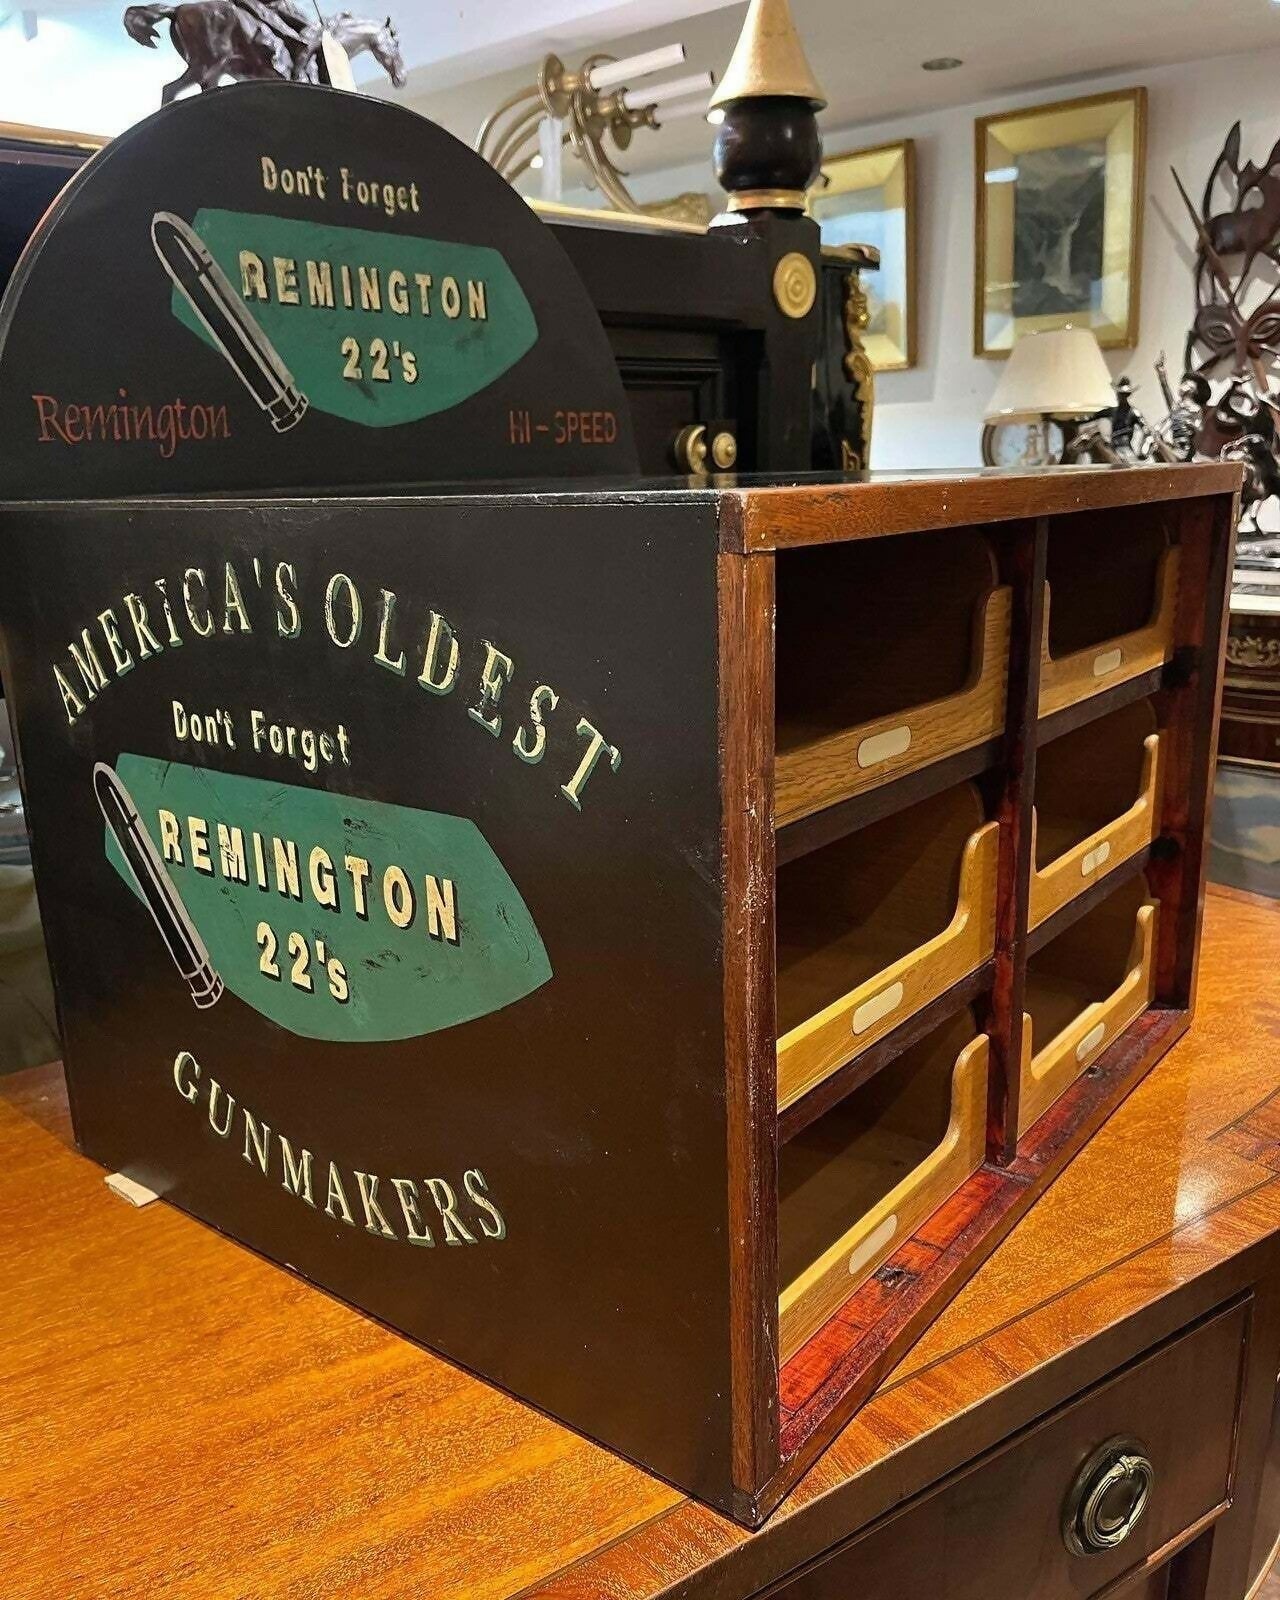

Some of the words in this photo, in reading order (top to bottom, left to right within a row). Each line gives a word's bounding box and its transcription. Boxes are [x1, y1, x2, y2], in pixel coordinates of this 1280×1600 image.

[261, 157, 328, 200] Don't
[341, 168, 421, 215] Forget
[239, 249, 489, 321] REMINGTON
[341, 337, 419, 384] 22's
[32, 388, 231, 458] Remington
[50, 558, 302, 725] AMERICA'S
[325, 573, 623, 811] OLDEST
[172, 700, 236, 749] Don't
[250, 710, 352, 773] Forget
[159, 808, 459, 945] REMINGTON
[256, 921, 351, 1003] 22's
[172, 1051, 507, 1248] GUNMAKERS
